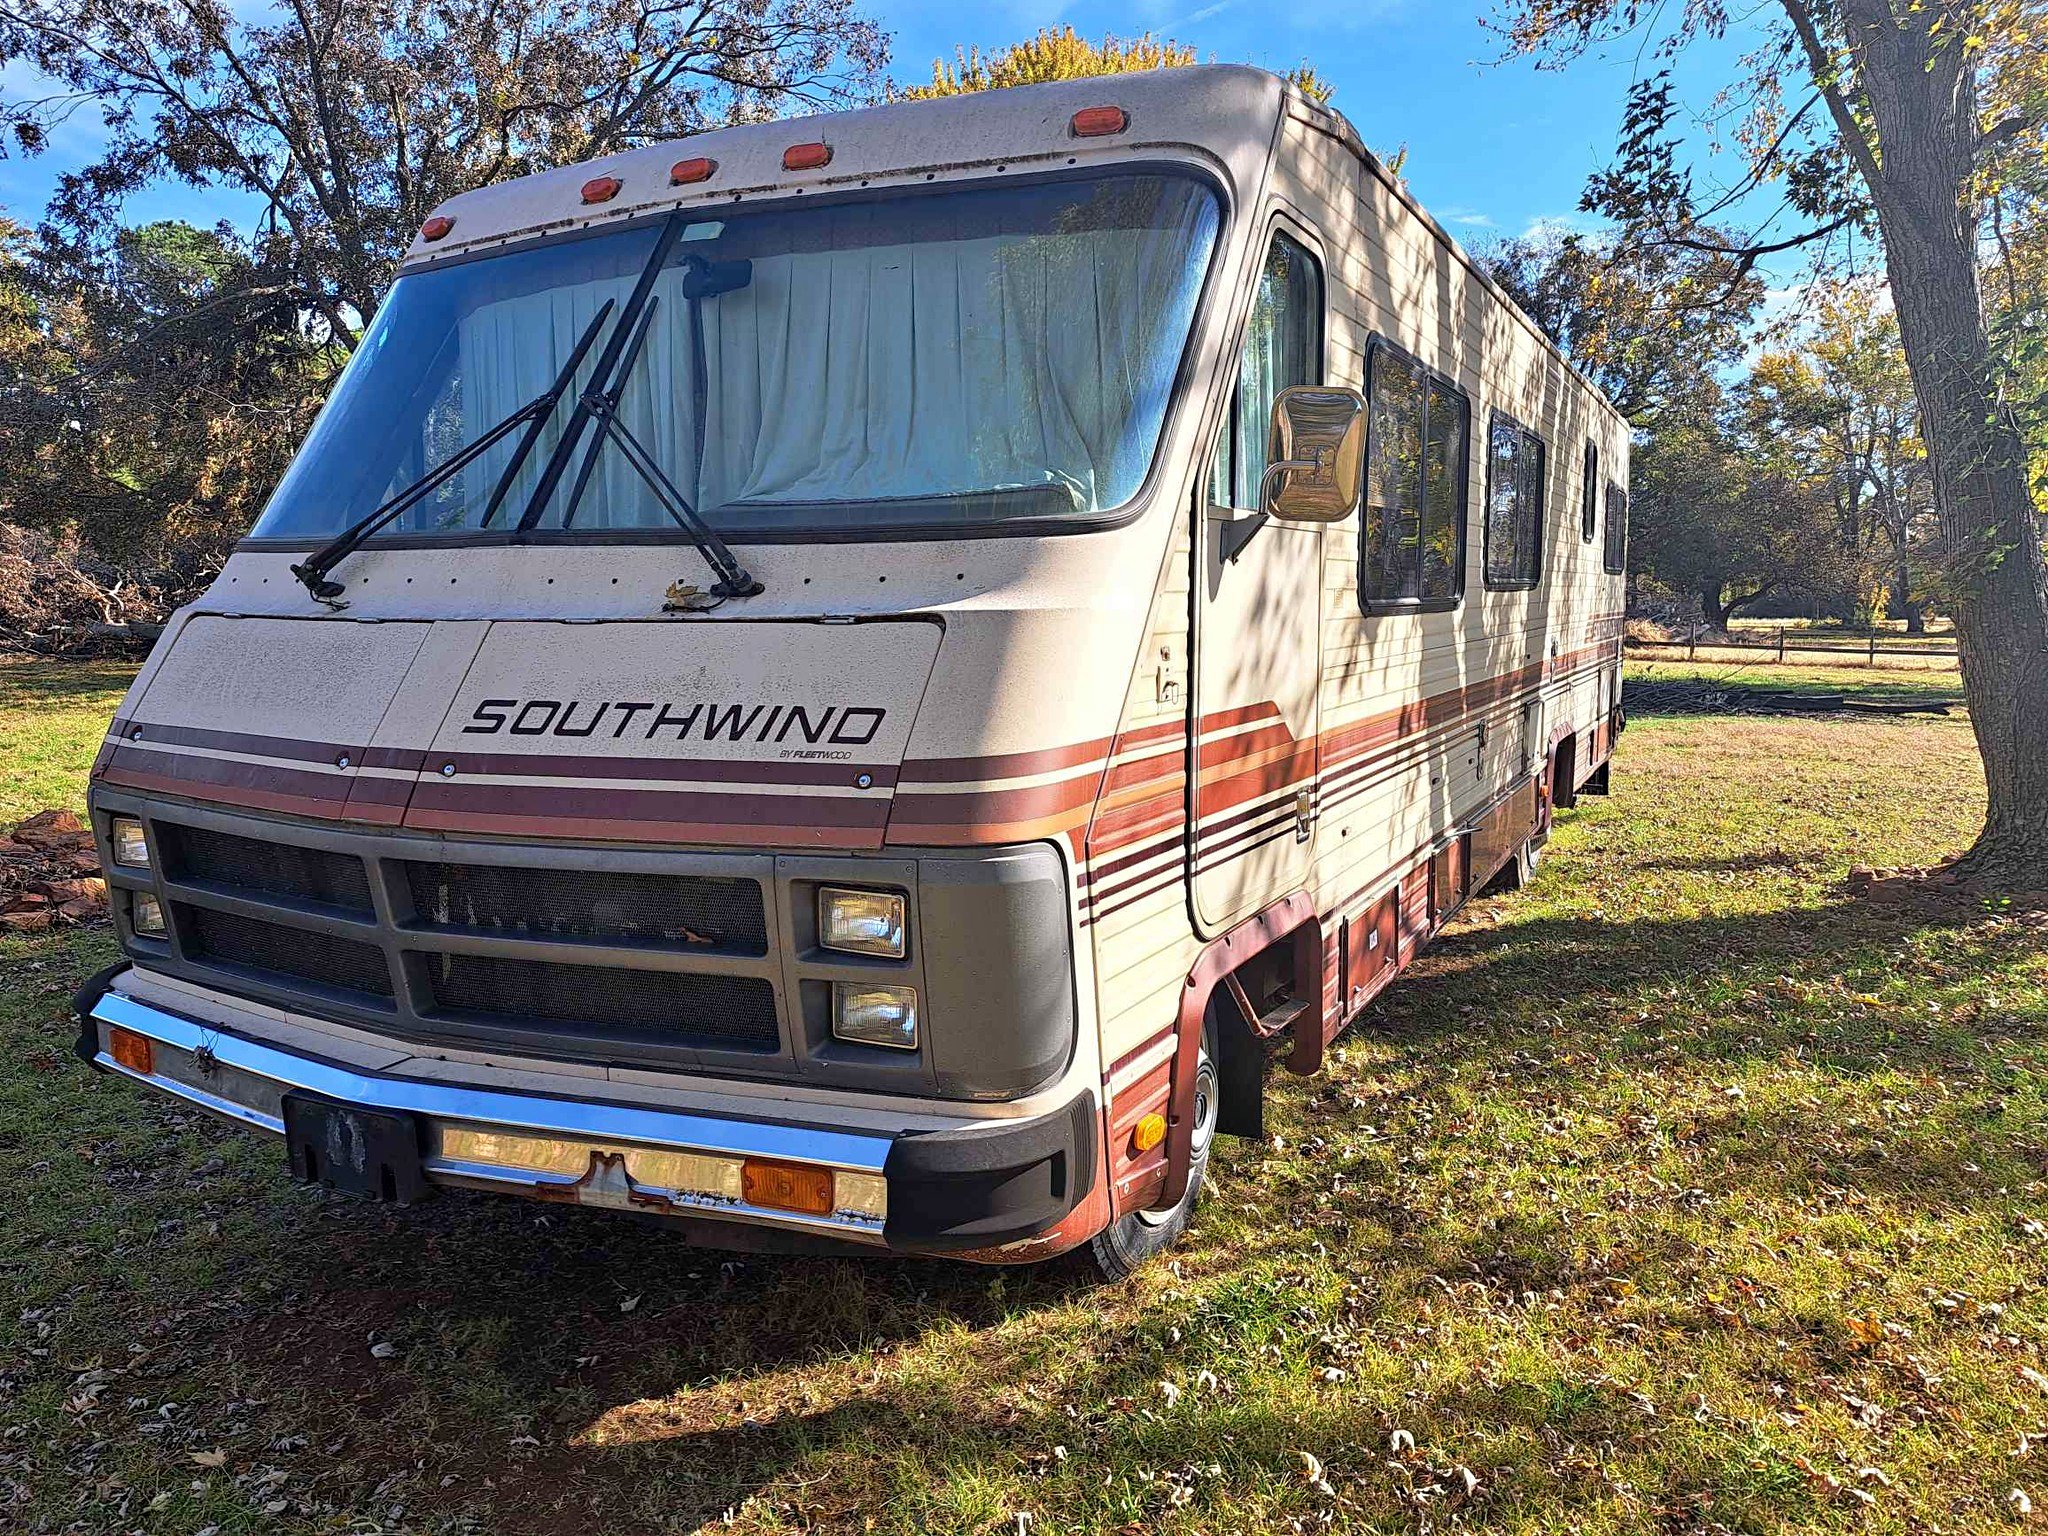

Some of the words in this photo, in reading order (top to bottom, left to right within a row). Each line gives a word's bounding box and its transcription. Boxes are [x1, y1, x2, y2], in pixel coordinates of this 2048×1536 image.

[461, 699, 887, 745] SOUTHWIND
[780, 749, 794, 759] BY
[793, 750, 852, 760] FLEETWOOD
